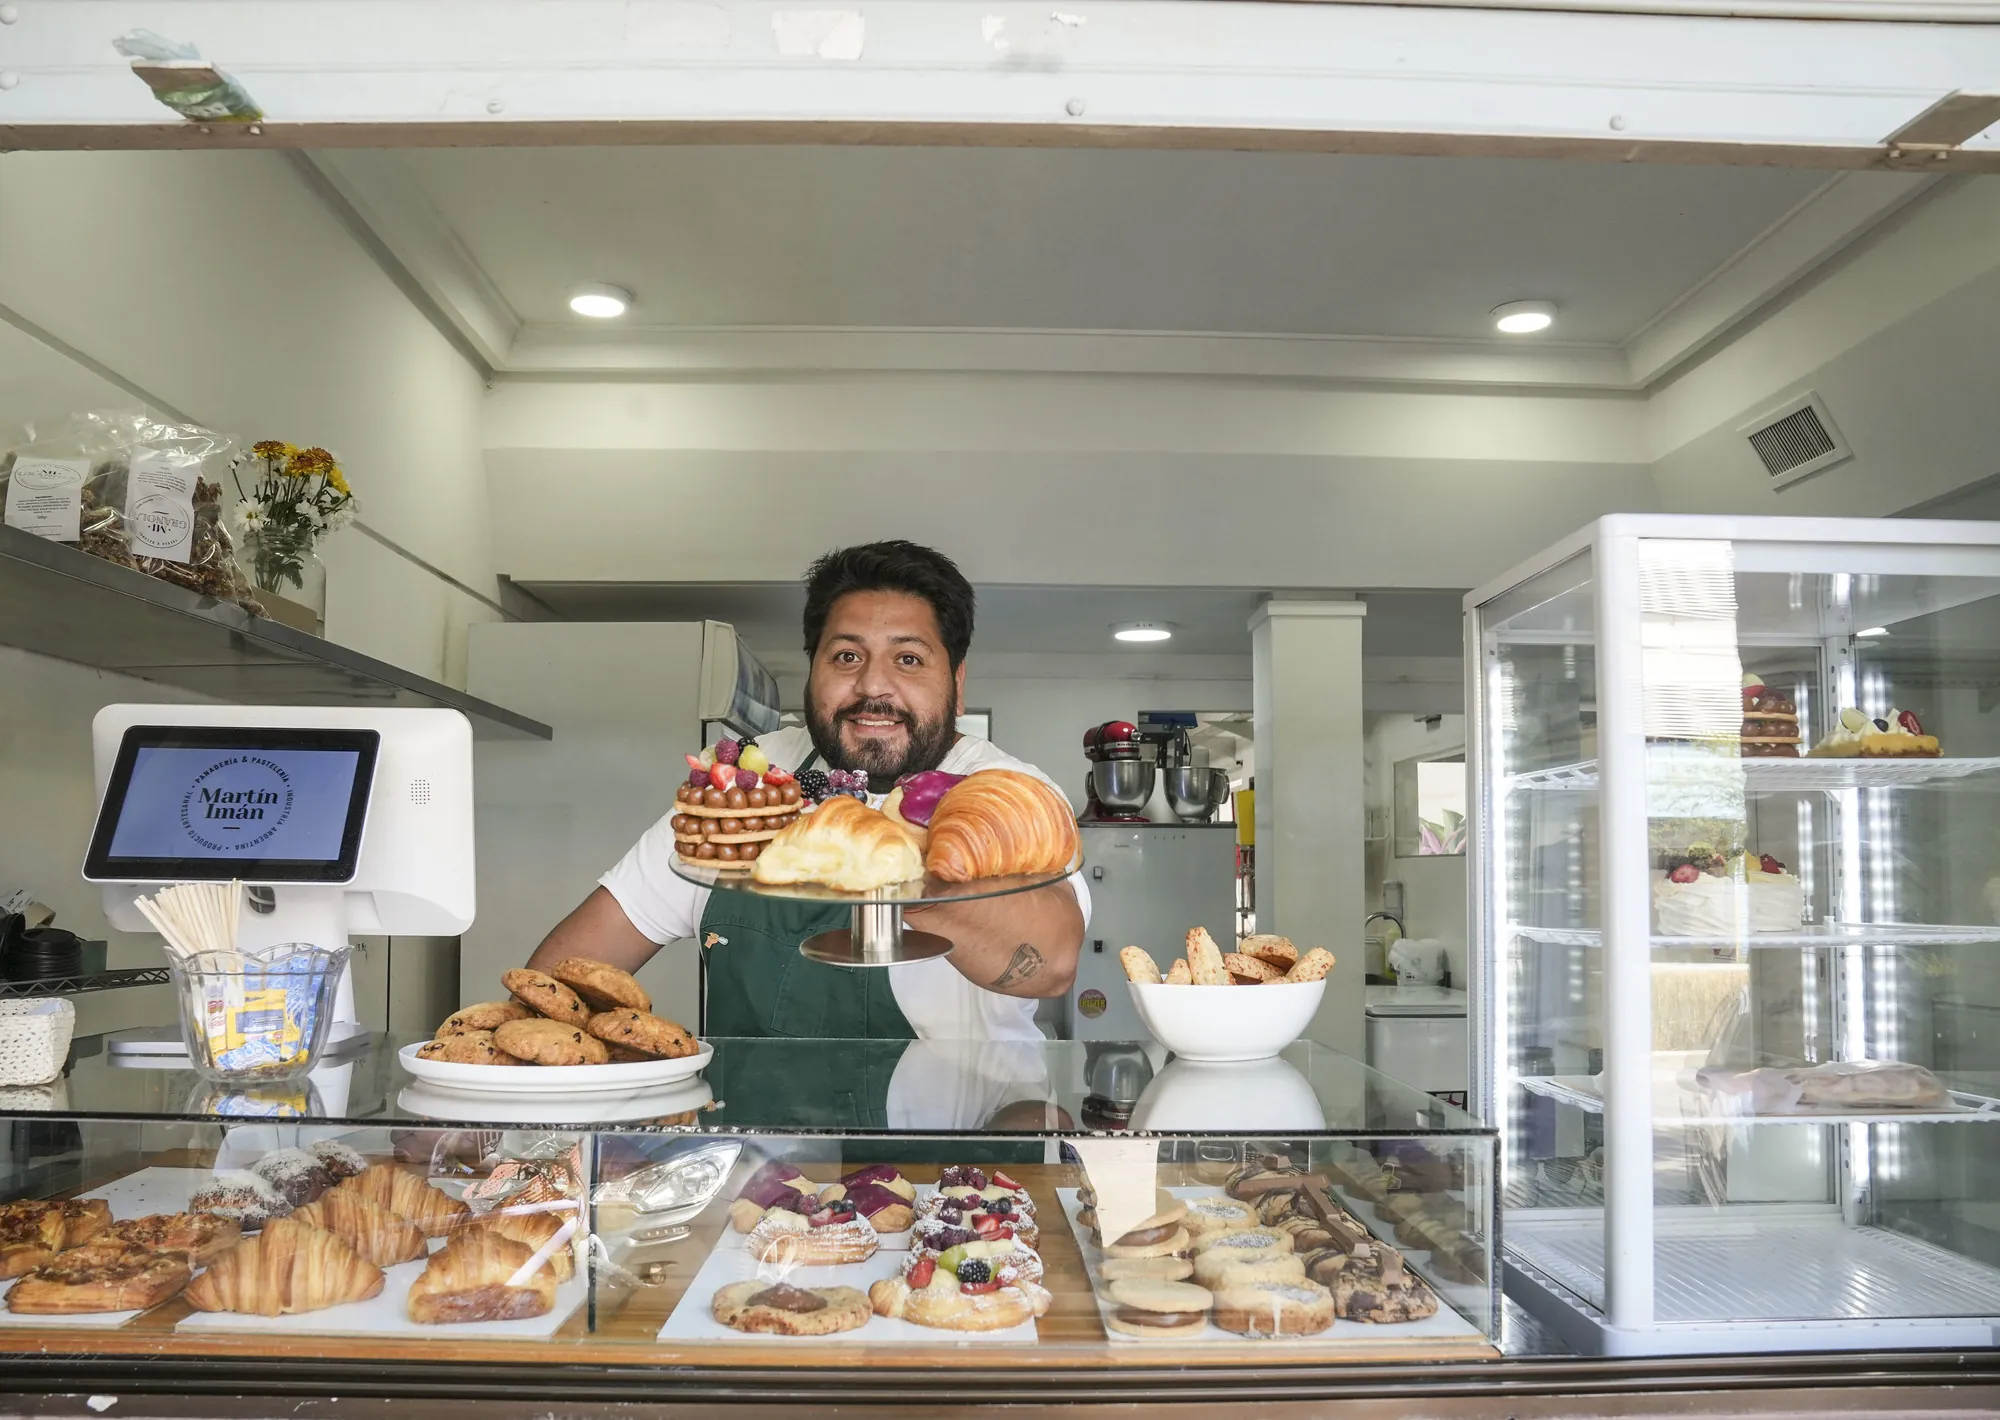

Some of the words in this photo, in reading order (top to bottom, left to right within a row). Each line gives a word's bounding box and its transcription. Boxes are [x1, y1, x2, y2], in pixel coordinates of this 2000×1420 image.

[152, 524, 167, 534] MI
[195, 757, 238, 783] PANADERÍA
[251, 757, 290, 783] PASTELERÍA
[197, 788, 278, 804] Martín
[276, 789, 294, 825] INDUSTRIA
[181, 791, 194, 829] ARTESANAL
[204, 804, 264, 820] Imán
[188, 829, 222, 851] PRODUCTO
[235, 826, 277, 850] ARGENTINA
